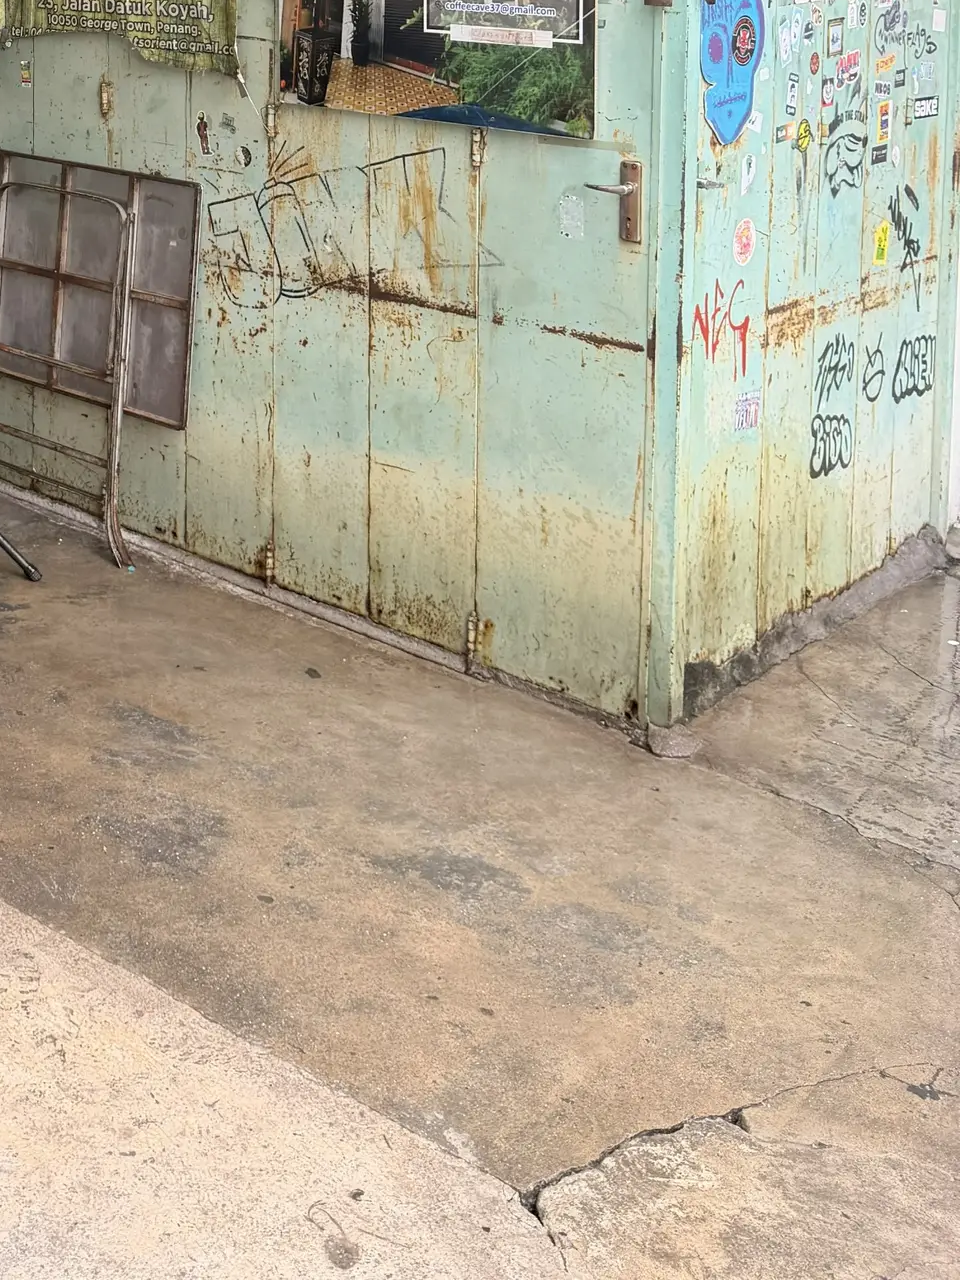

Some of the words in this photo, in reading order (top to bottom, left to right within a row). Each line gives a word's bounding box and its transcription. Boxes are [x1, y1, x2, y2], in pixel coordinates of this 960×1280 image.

[156, 0, 214, 22] Koyah,
[445, 0, 556, 17] coffeecave37@gmail.com
[47, 14, 78, 27] 10050
[80, 17, 118, 31] George
[120, 19, 154, 35] Town,
[157, 22, 202, 37] Penang.
